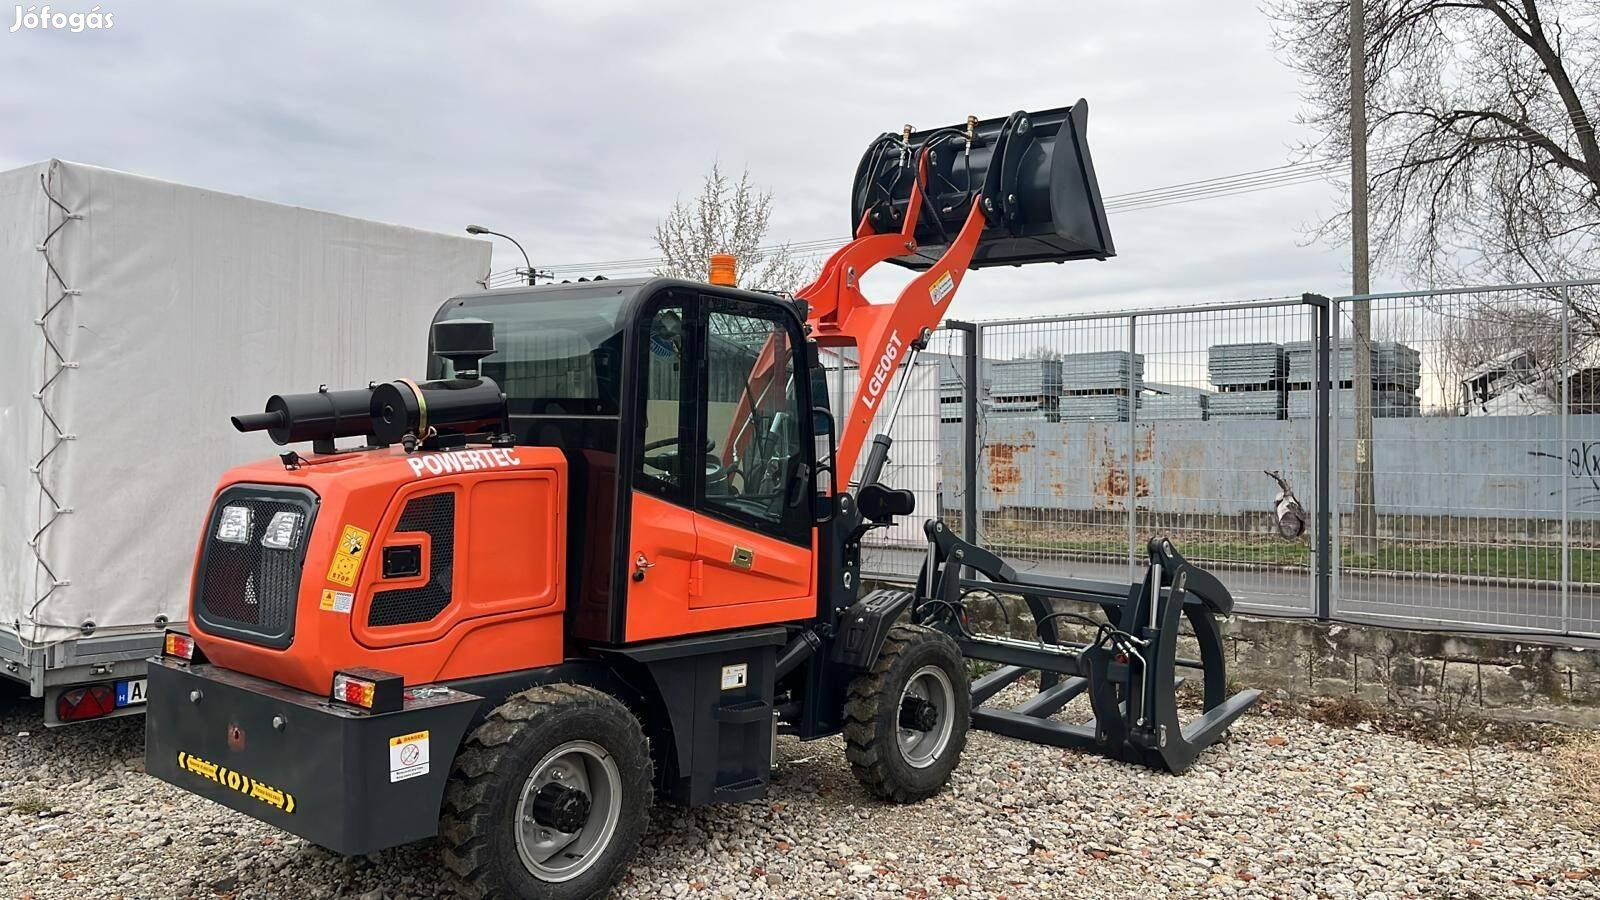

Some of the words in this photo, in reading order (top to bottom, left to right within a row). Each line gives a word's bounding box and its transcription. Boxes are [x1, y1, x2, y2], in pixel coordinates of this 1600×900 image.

[861, 329, 903, 410] LGE06T
[406, 447, 521, 478] POWERTEC
[332, 572, 350, 582] STOP
[119, 694, 126, 702] H
